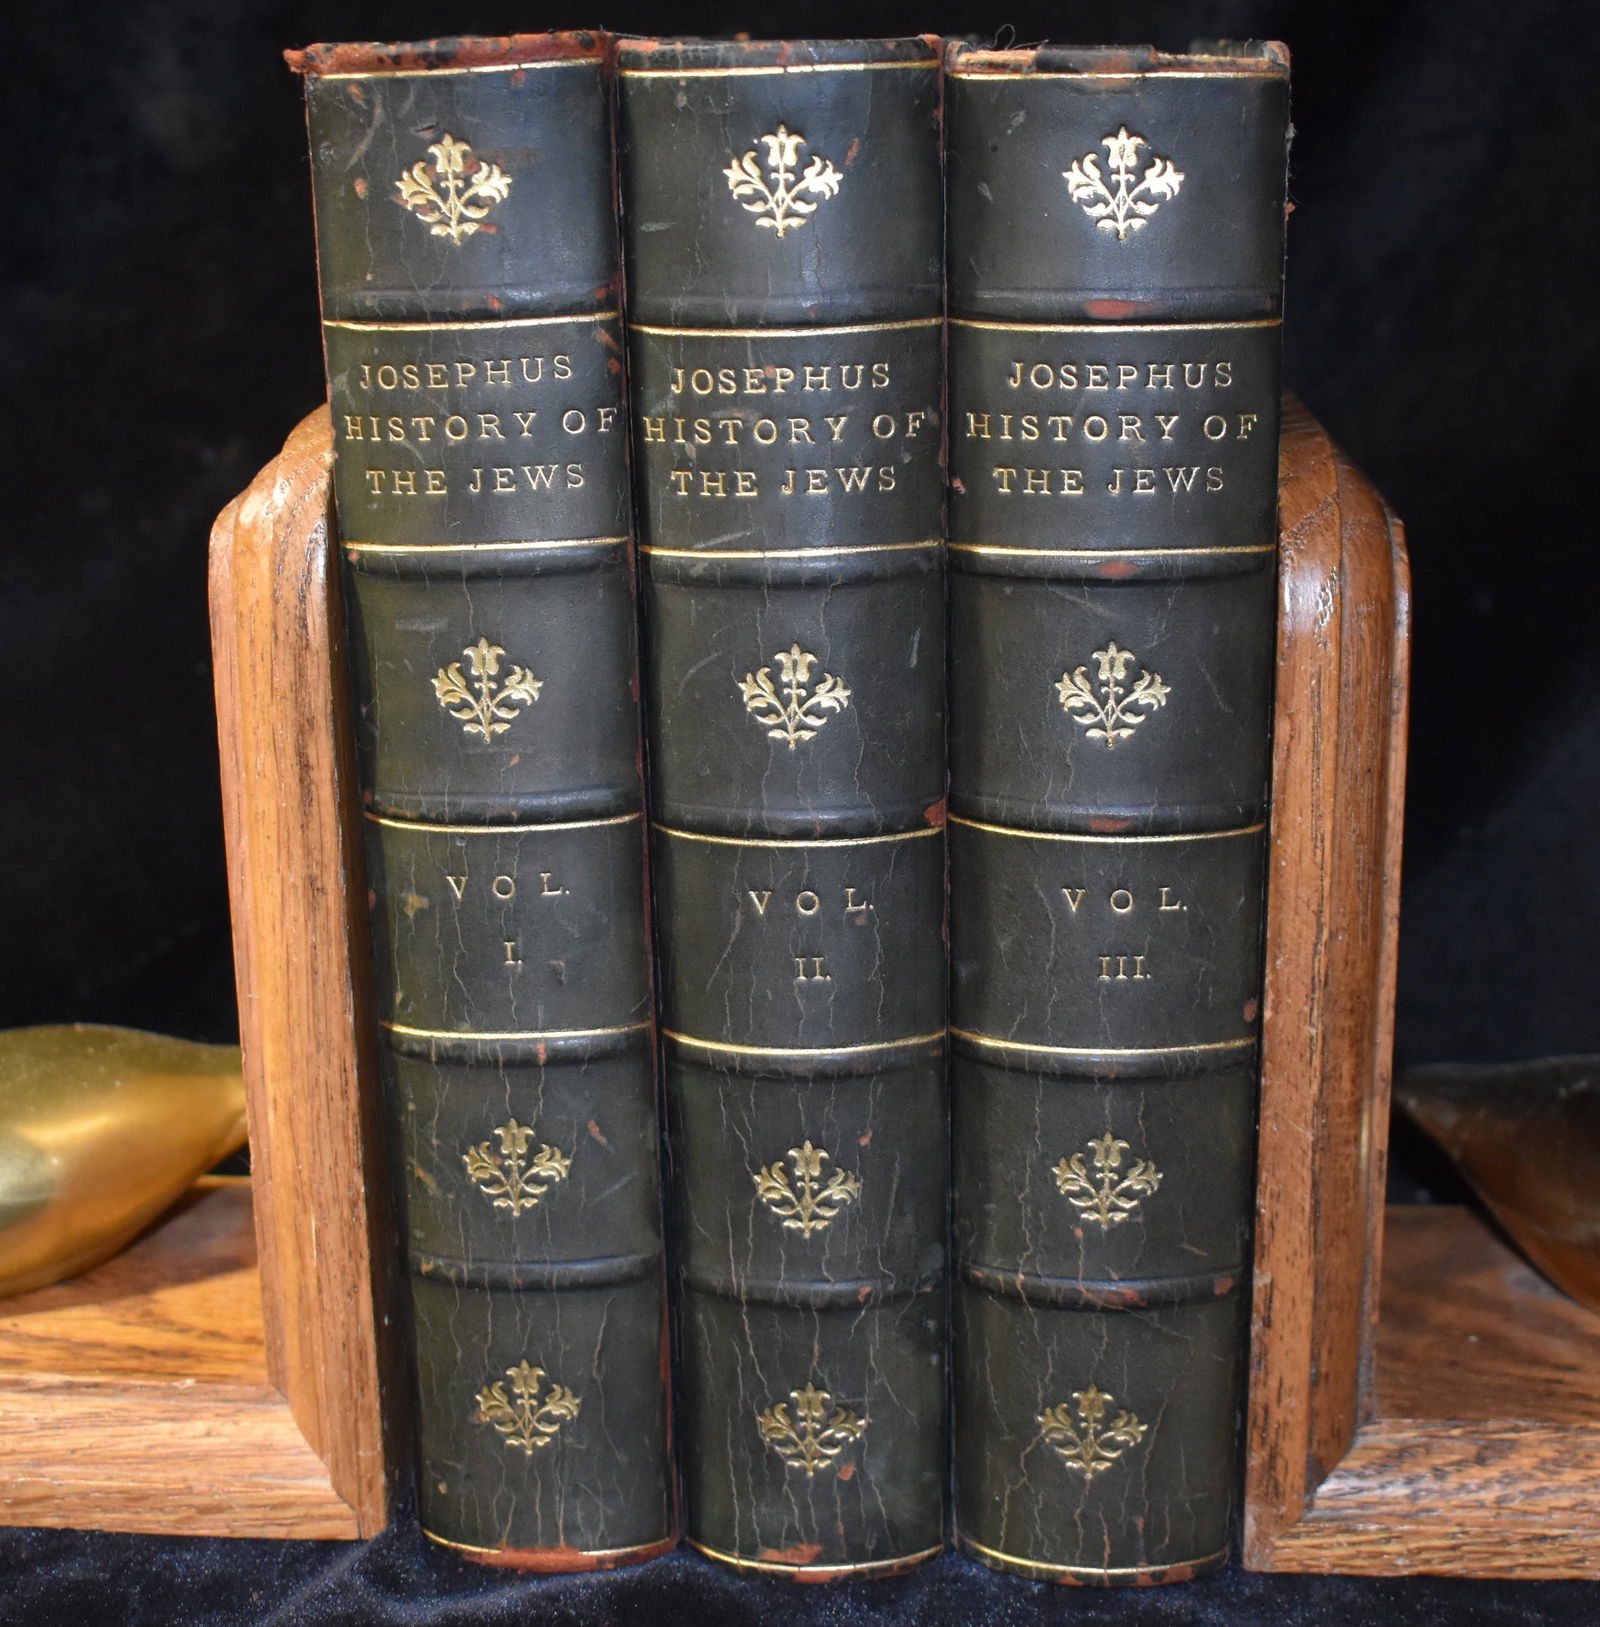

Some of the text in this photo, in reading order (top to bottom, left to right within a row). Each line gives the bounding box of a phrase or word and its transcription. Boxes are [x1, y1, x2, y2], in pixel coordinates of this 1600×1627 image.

[359, 354, 573, 390] JOSEPHUS
[671, 362, 890, 395] JOSEPHUS
[1008, 362, 1233, 390] JOSEPHUS
[344, 407, 618, 441] HISTORY OF
[643, 411, 926, 445] HISTORY OF
[966, 412, 1258, 442] HISTORY OF
[365, 463, 585, 495] THE JEWS
[670, 465, 897, 497] THE JEWS
[993, 467, 1224, 495] THE JEWS
[504, 941, 523, 965] I.
[1098, 956, 1151, 981] III.
[794, 957, 832, 982] II.
